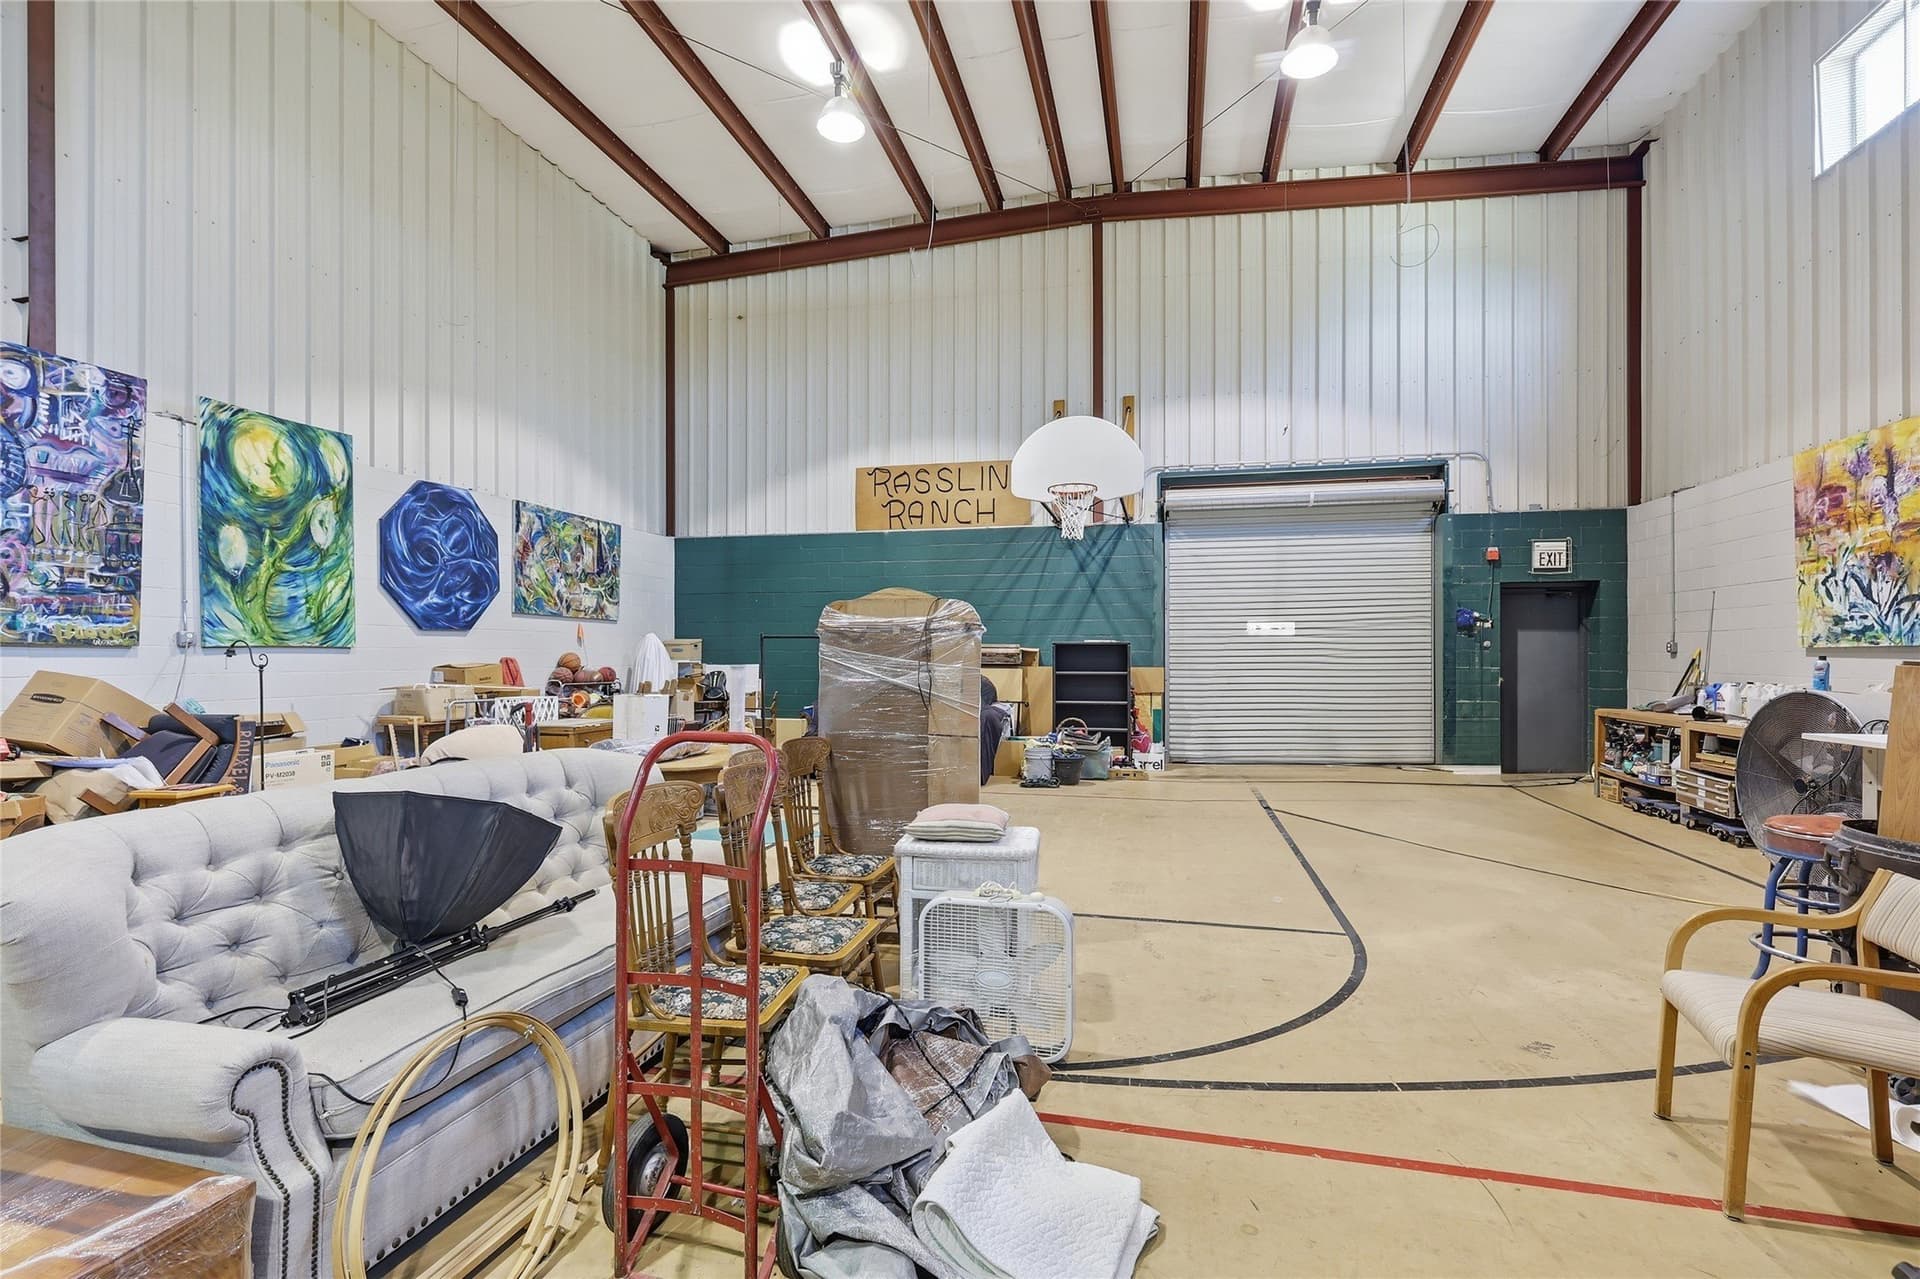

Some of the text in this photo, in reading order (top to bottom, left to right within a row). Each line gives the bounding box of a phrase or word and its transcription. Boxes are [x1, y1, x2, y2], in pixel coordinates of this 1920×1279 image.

[867, 464, 1009, 498] RASSLIN
[881, 498, 996, 530] RANCH
[1539, 551, 1564, 567] EXIT
[265, 759, 301, 769] Panasonic
